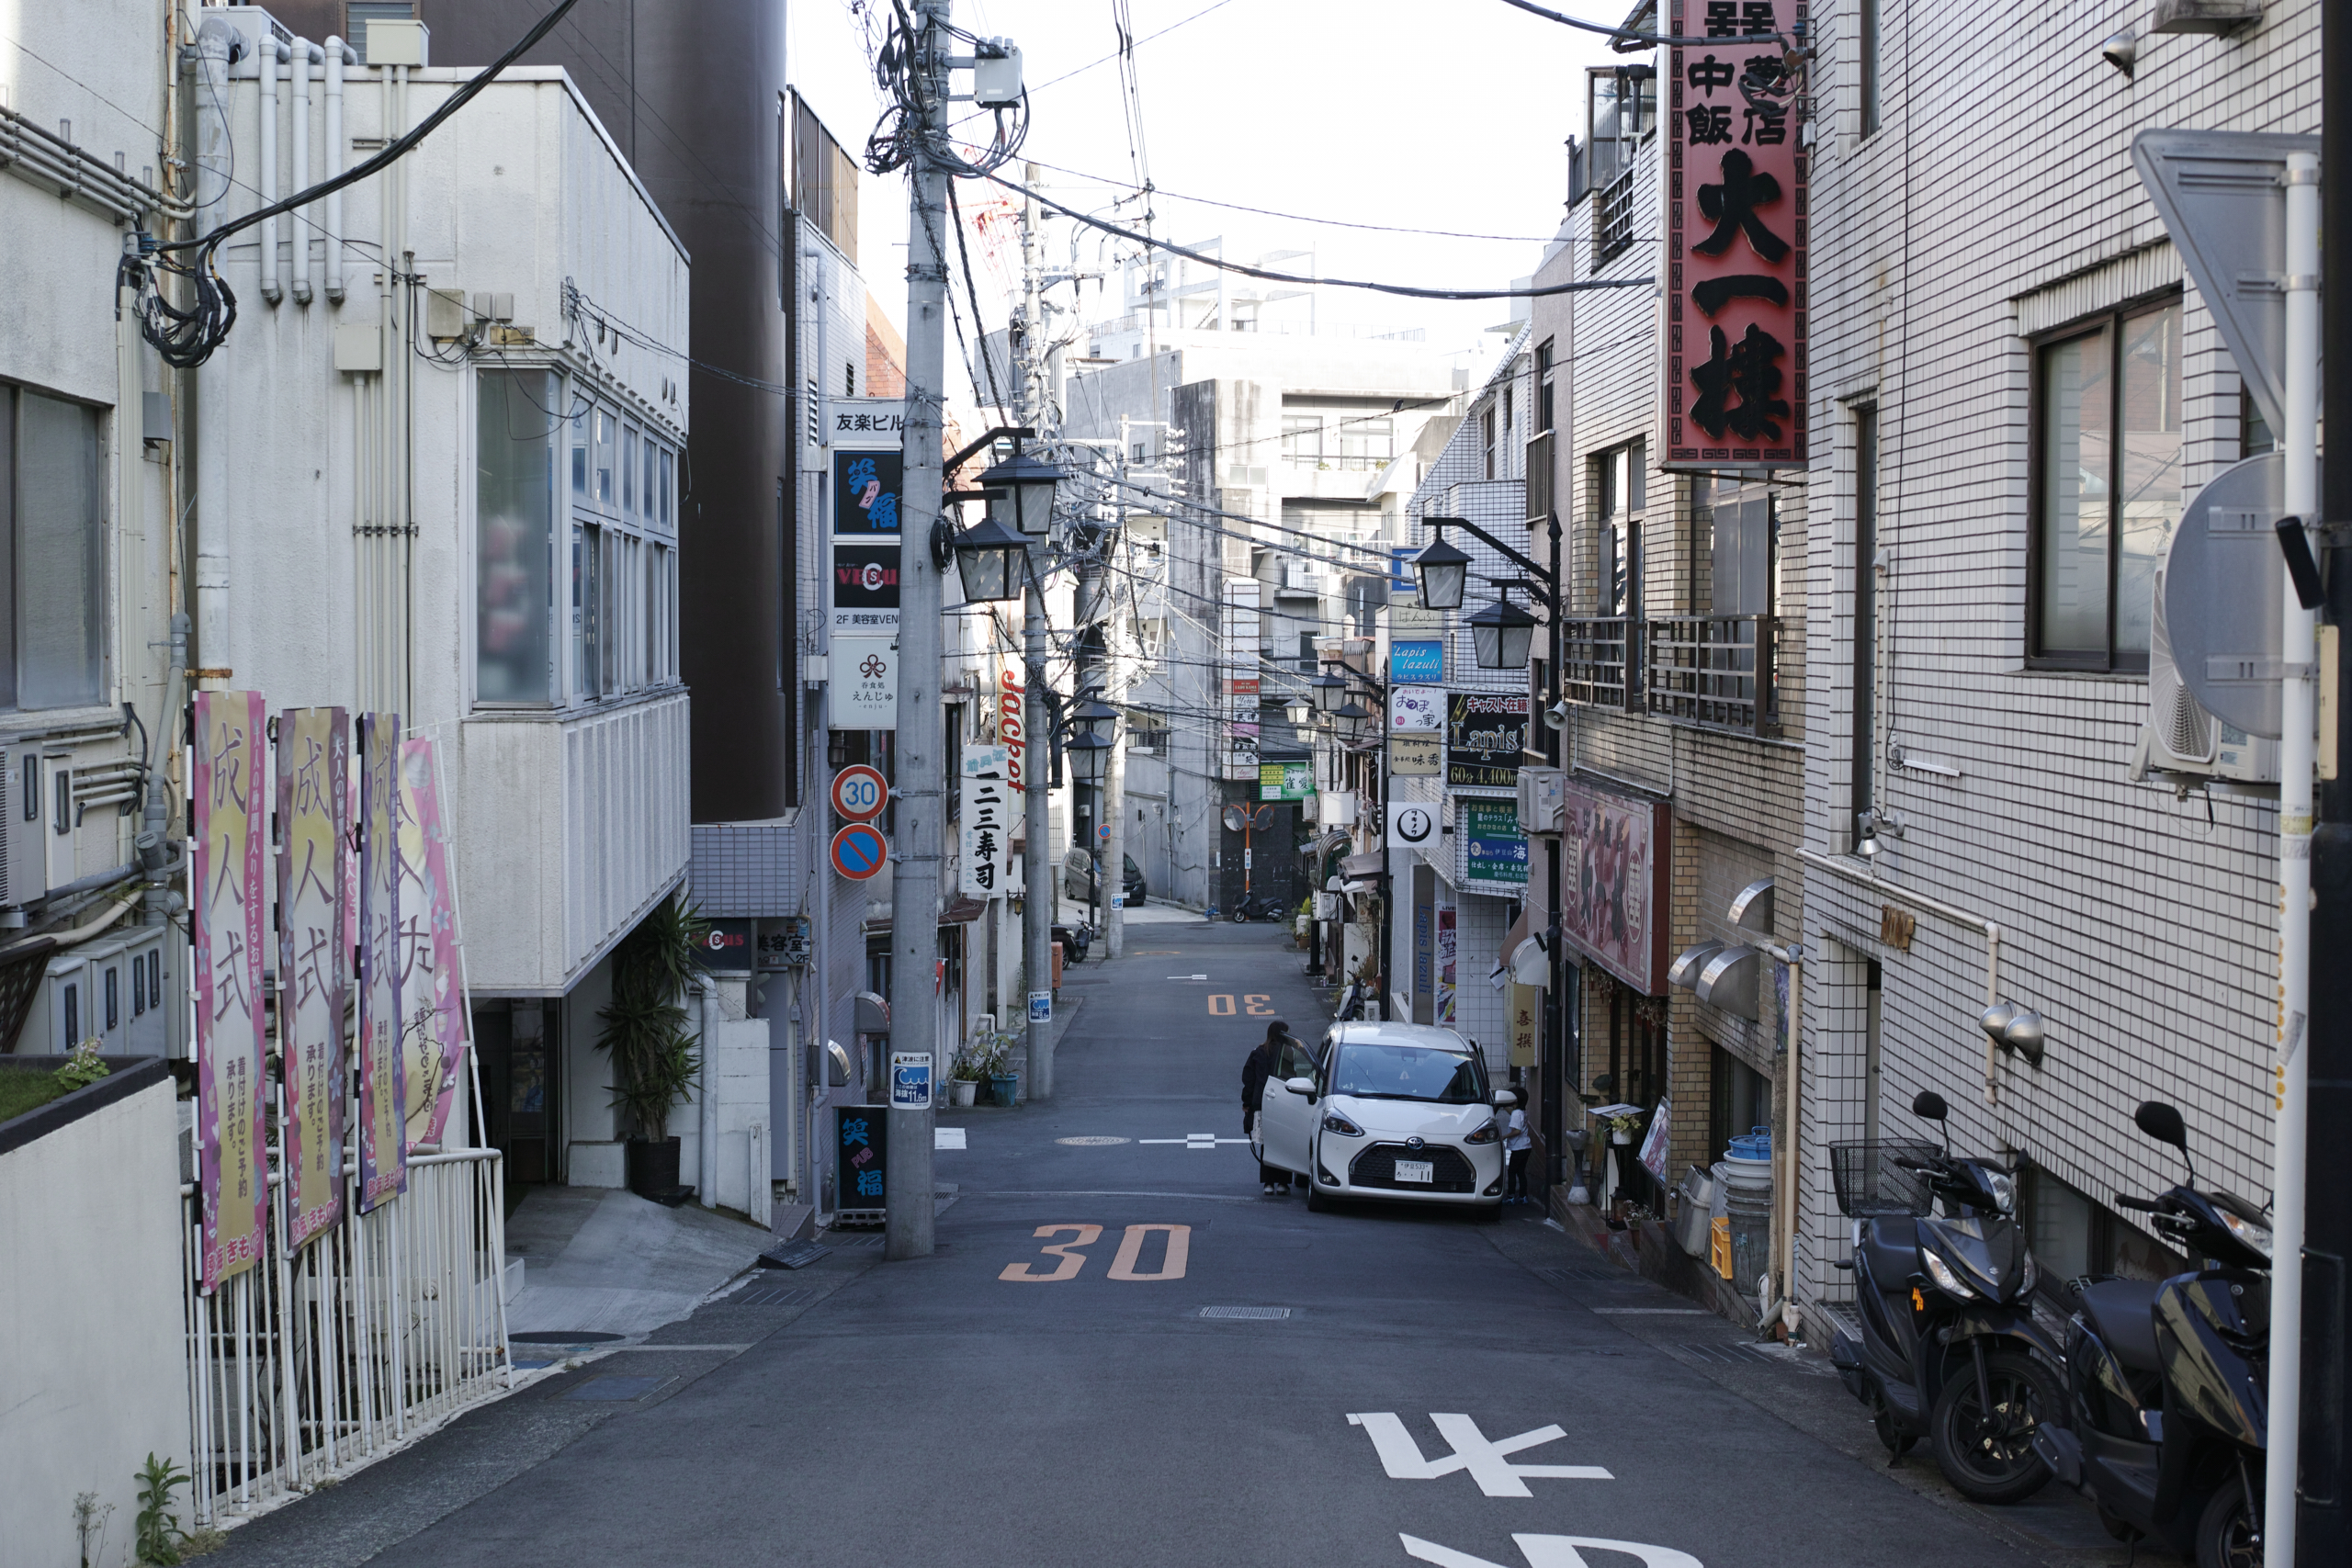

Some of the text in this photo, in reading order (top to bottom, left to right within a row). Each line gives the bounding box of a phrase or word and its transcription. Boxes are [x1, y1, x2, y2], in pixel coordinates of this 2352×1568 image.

[837, 413, 903, 432] 友楽ビル
[836, 614, 899, 625] 2F 美容室VEN
[1394, 647, 1427, 658] Lapis
[1402, 659, 1440, 671] lazuli
[853, 692, 894, 702] えんじゅ
[1467, 696, 1530, 714] キャスト在籍
[1451, 722, 1518, 761] Lapis
[1451, 766, 1474, 784] 60分
[845, 782, 875, 806] 30
[973, 772, 1001, 891] 一二三寿司
[210, 721, 251, 1024] 成人式
[292, 735, 336, 1011] 成人式
[371, 738, 391, 990] 成人式
[796, 954, 809, 964] 2F
[1419, 903, 1431, 994] Lapis lazuli
[1207, 993, 1275, 1016] 30
[226, 1059, 236, 1150] 承ります。
[236, 1055, 248, 1199] 着付けのご予約
[851, 1146, 874, 1168] PUB
[998, 1224, 1192, 1282] 30
